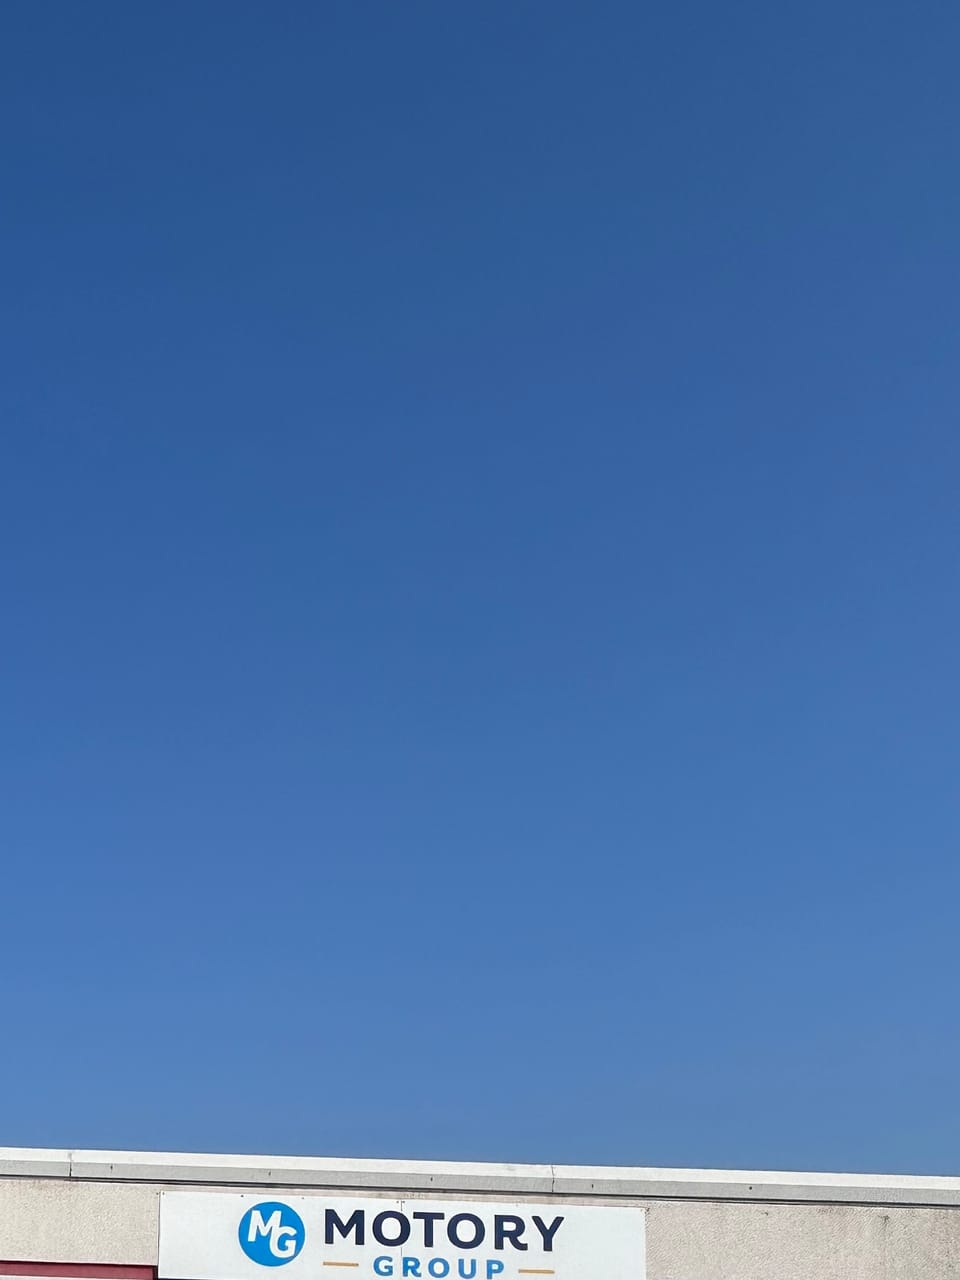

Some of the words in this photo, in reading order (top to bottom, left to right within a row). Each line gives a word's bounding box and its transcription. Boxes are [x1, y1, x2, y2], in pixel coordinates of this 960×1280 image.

[247, 1209, 297, 1258] MG
[324, 1208, 565, 1252] MOTORY
[373, 1255, 505, 1280] GROUP
